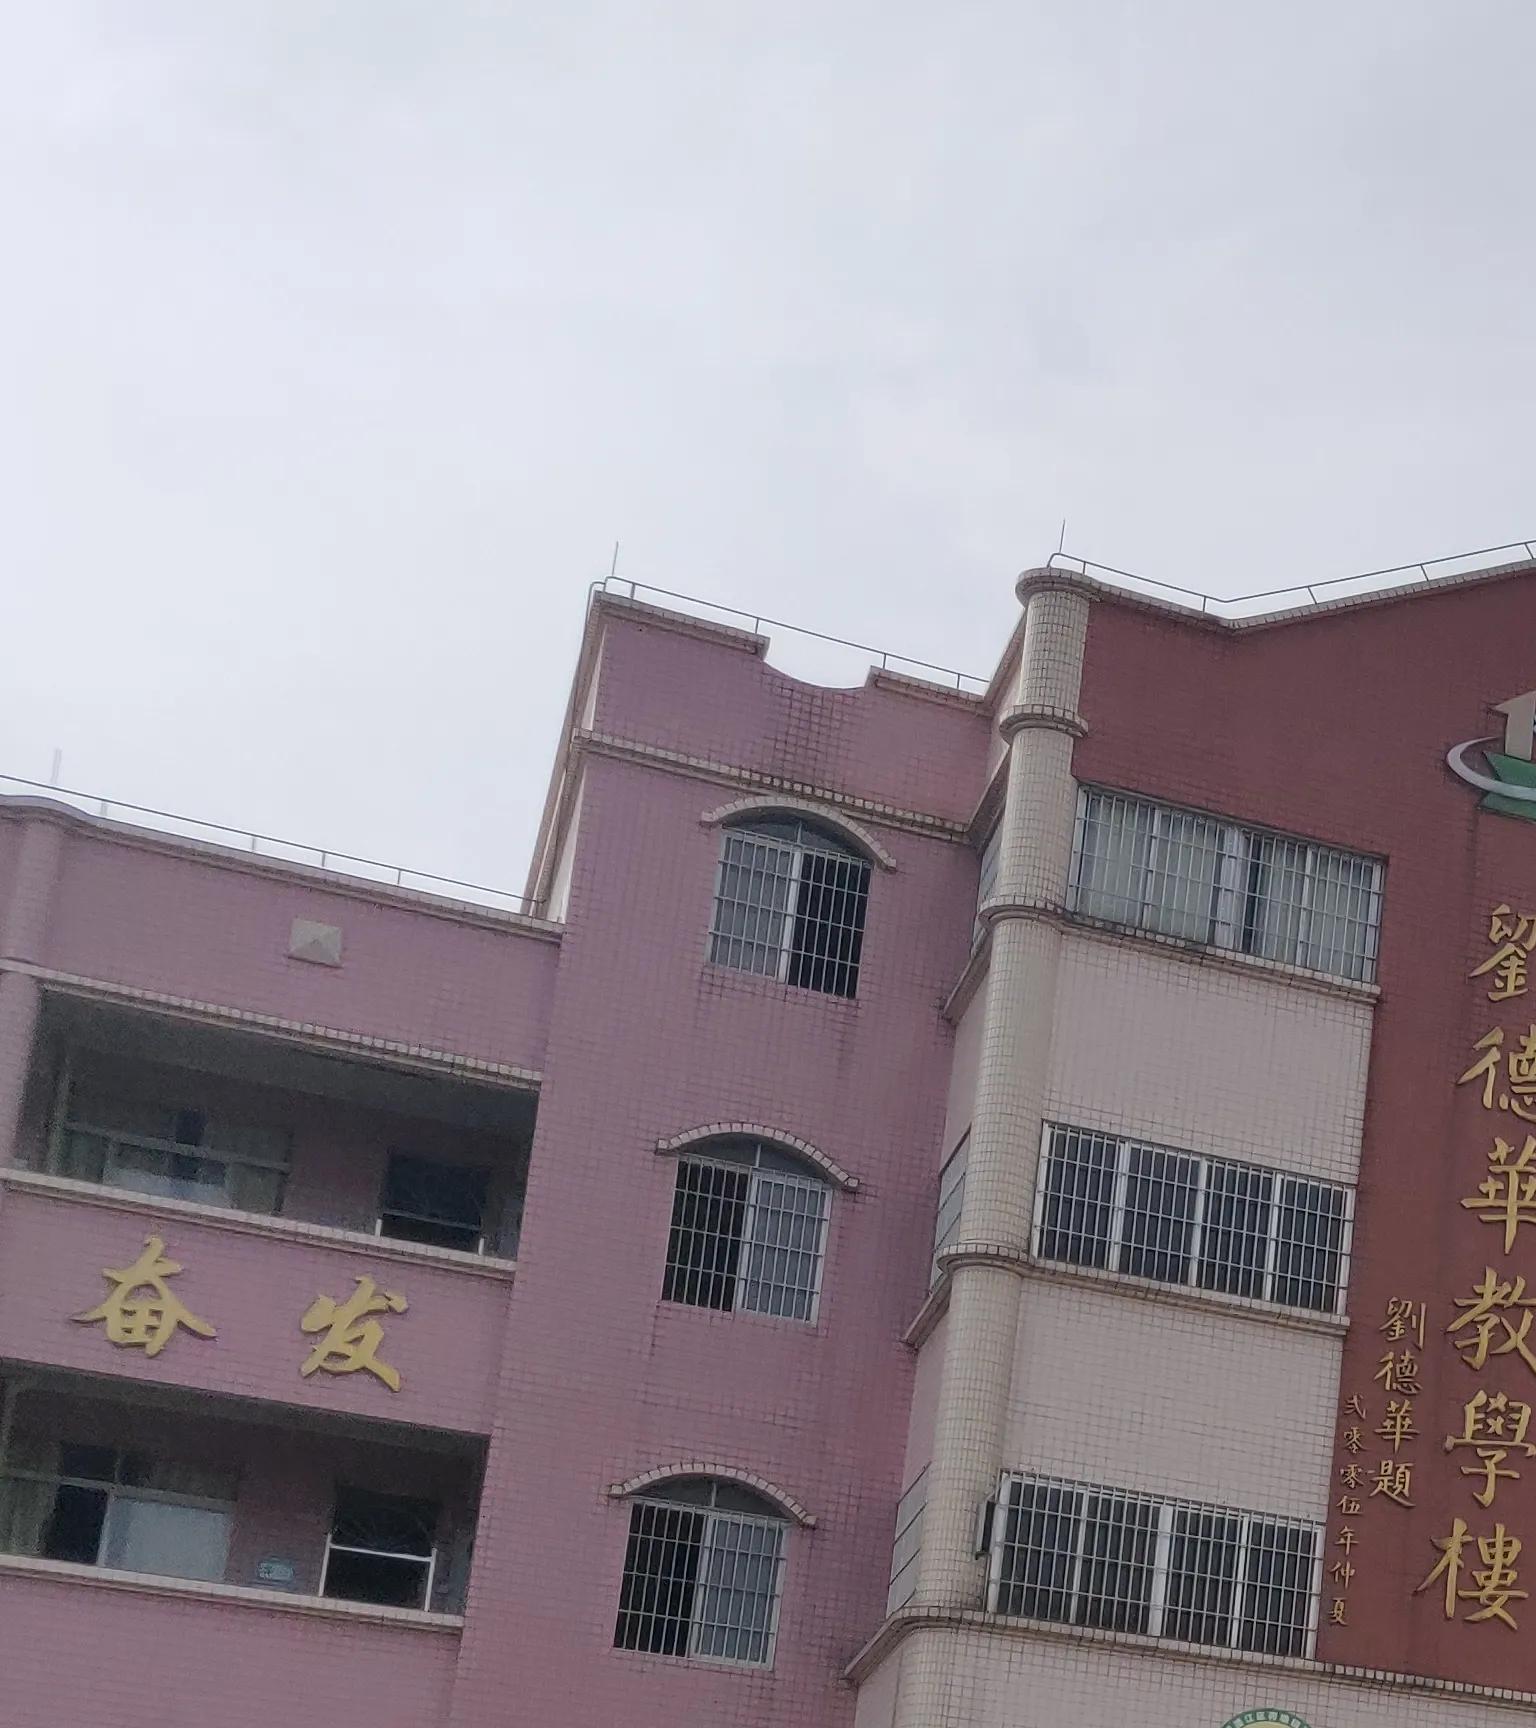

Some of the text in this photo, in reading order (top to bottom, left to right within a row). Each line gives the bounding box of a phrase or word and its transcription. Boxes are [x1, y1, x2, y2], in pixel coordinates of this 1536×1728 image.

[70, 1234, 409, 1393] 奋发
[1369, 1296, 1427, 1509] 劉德華題
